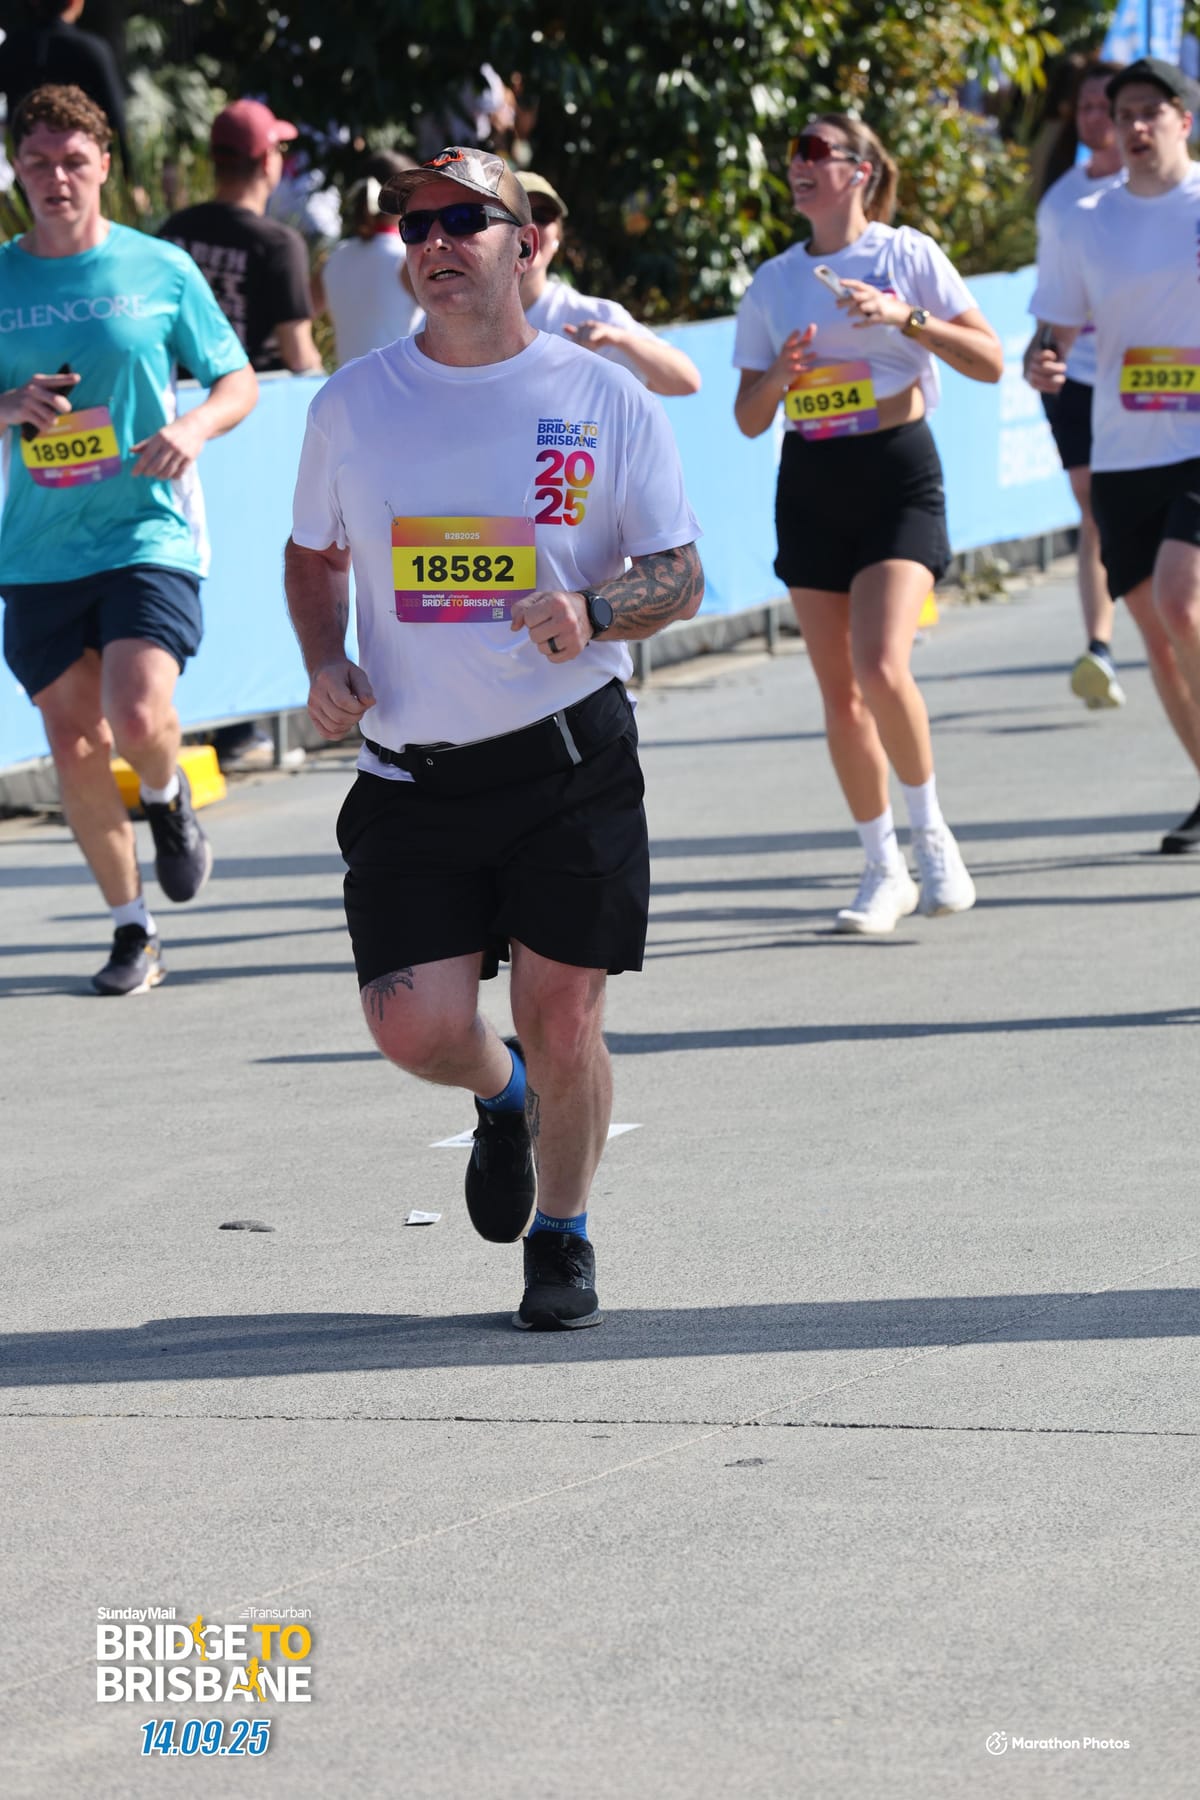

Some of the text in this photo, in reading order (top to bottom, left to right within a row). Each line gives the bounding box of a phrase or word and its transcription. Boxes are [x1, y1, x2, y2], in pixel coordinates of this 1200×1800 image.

[0, 294, 147, 333] GLENCORE
[793, 387, 862, 415] 16934
[536, 434, 598, 449] BRISBANE
[537, 423, 598, 437] BRIDGE TO
[32, 435, 103, 462] 18902
[535, 449, 595, 488] 20
[535, 487, 588, 526] 25
[412, 555, 514, 583] 18582
[422, 598, 451, 607] BRIDGE
[452, 599, 463, 607] TO
[463, 598, 505, 607] BRISBANE
